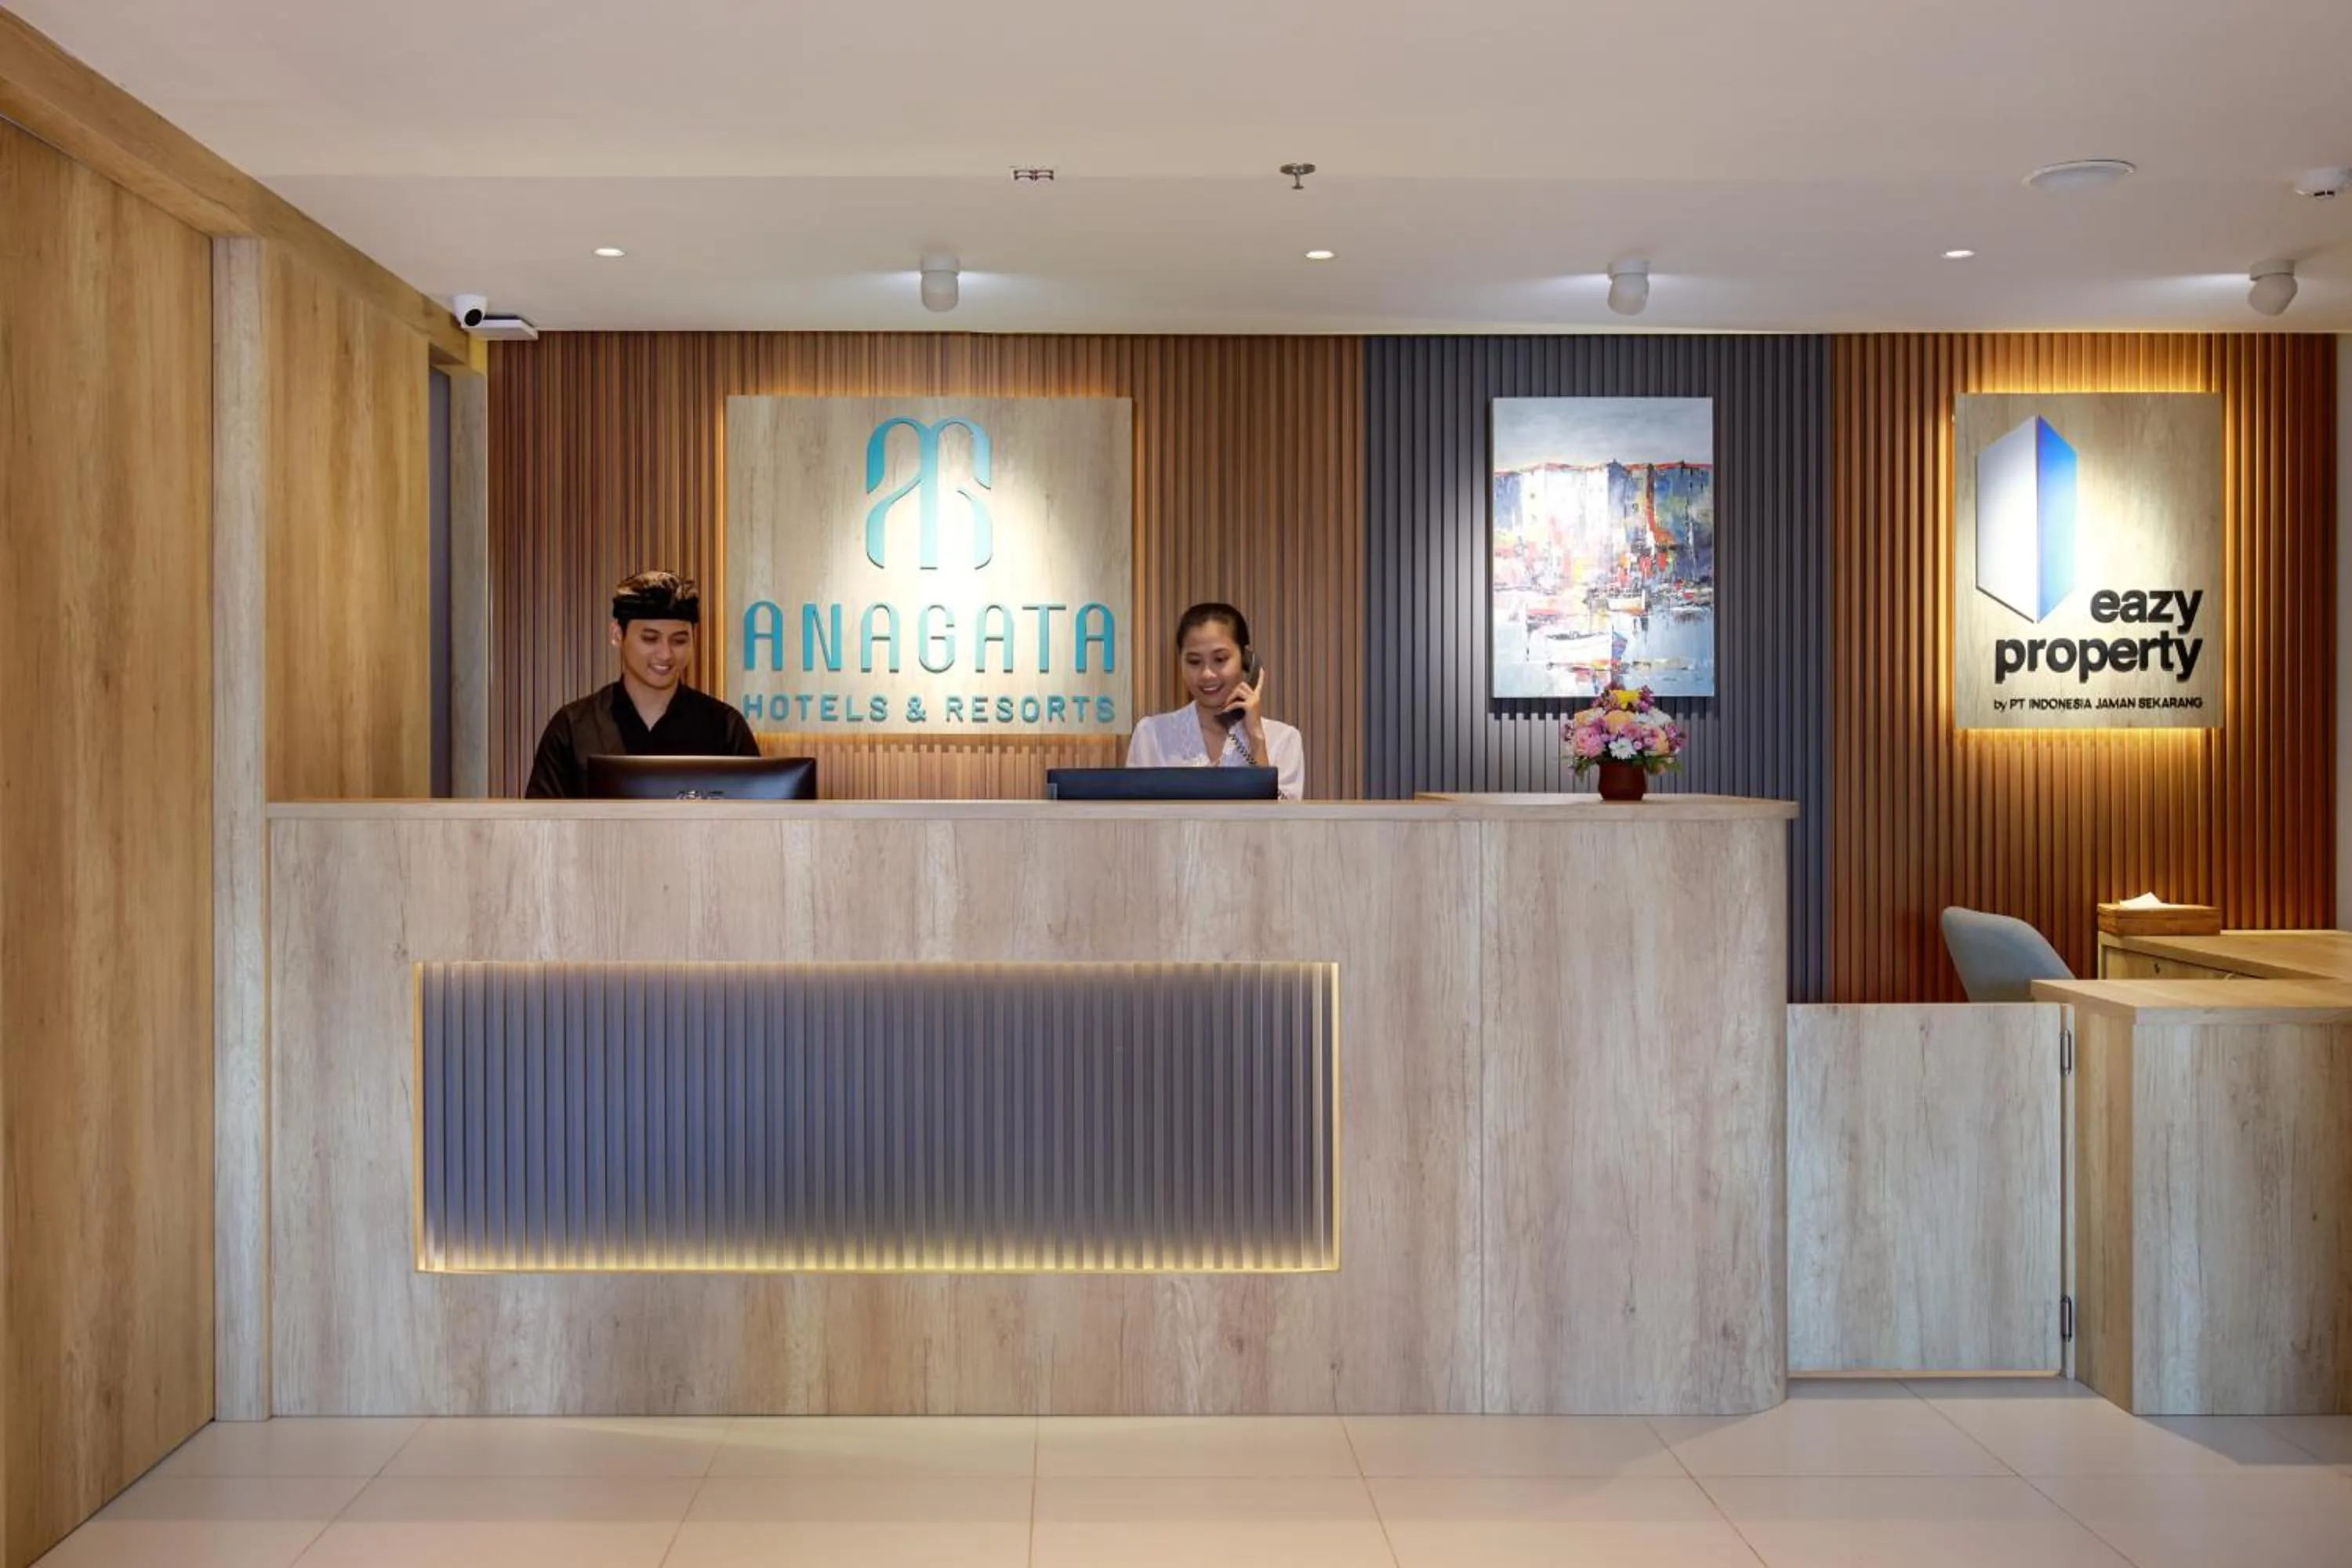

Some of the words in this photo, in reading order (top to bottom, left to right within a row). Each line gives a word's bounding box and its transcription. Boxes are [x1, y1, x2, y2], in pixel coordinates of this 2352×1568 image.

[2090, 589, 2203, 634] eazy
[743, 601, 1115, 673] ANAGATA
[1994, 630, 2203, 684] property
[742, 694, 889, 722] HOTELS
[906, 695, 927, 723] &
[946, 695, 1116, 723] RESORTS
[1994, 699, 2007, 712] by
[2009, 699, 2025, 710] PT
[2028, 699, 2092, 710] INDONESIA
[2096, 697, 2136, 709] JAMAN
[2138, 697, 2202, 709] SEKARANG
